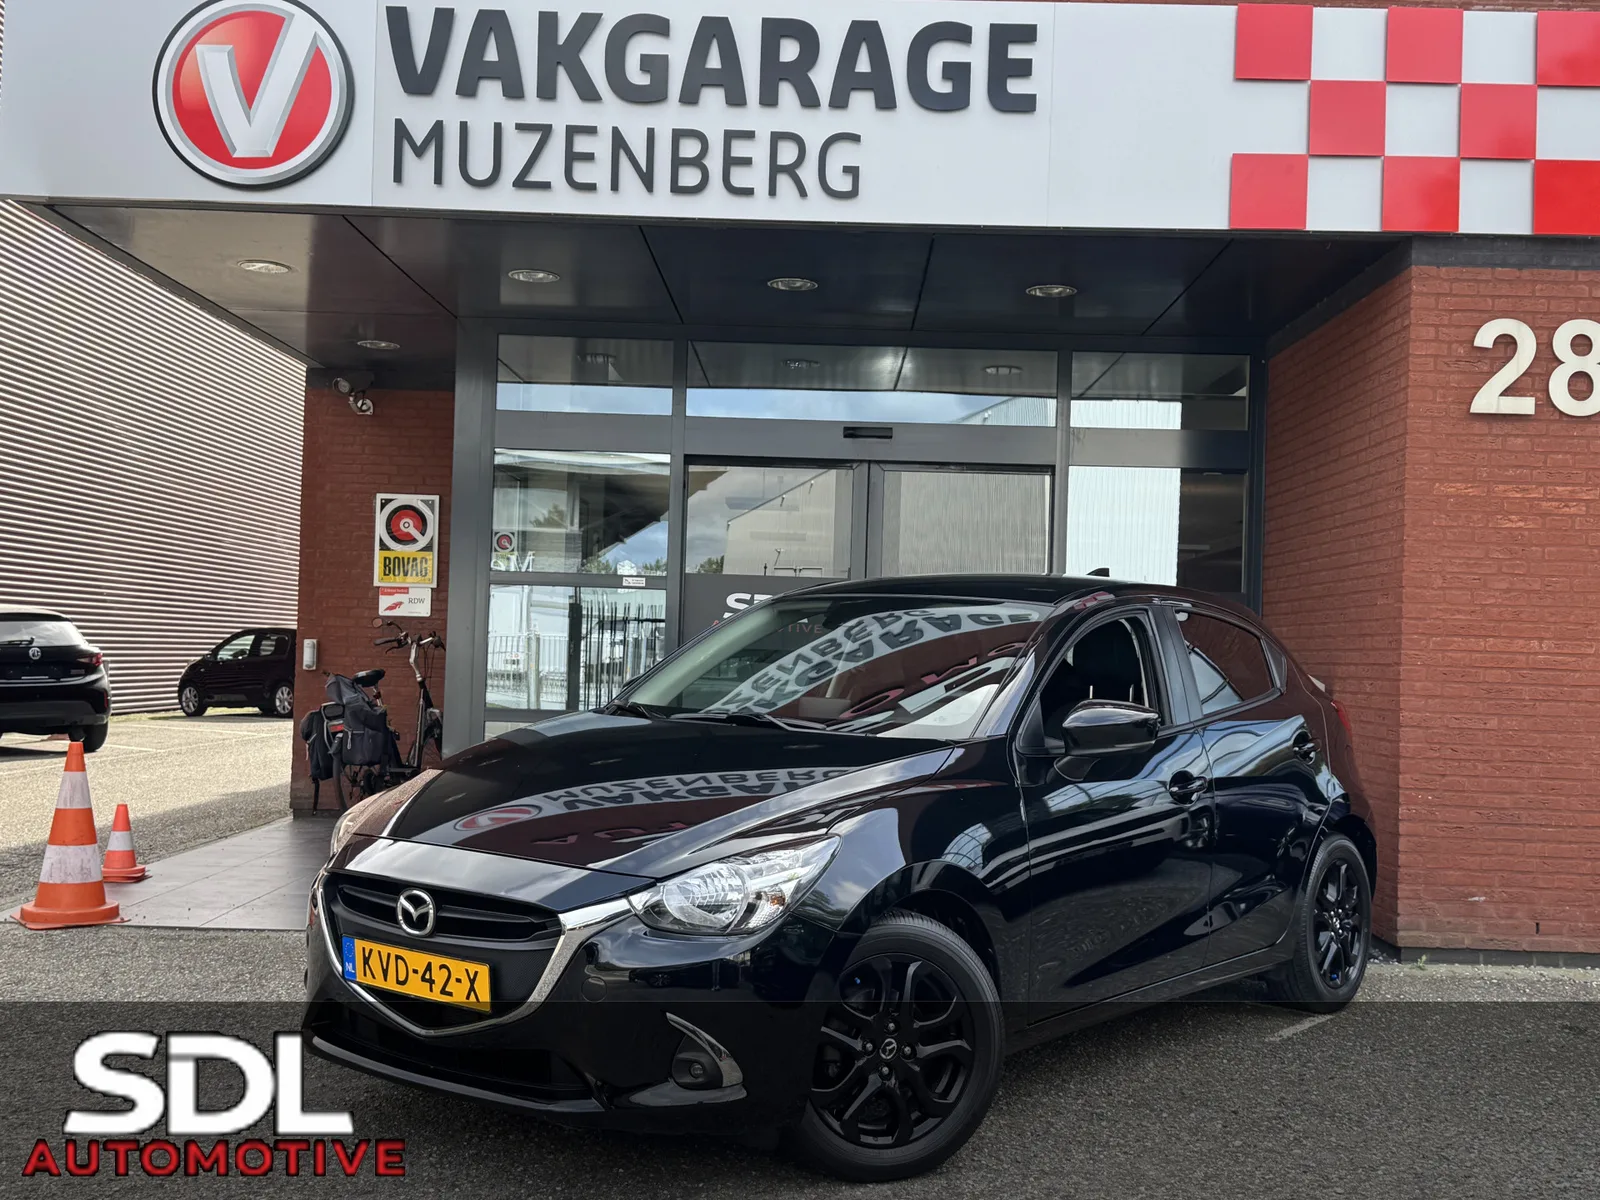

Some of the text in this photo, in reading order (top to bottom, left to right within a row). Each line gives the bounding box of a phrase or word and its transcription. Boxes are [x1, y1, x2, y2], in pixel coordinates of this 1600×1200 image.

[386, 6, 1037, 112] VAKGARAGE
[393, 118, 861, 199] MUZENBERG
[1470, 318, 1600, 416] 28
[383, 556, 429, 578] BOVAG
[345, 961, 356, 973] NL
[361, 946, 481, 1003] KVD-42-X
